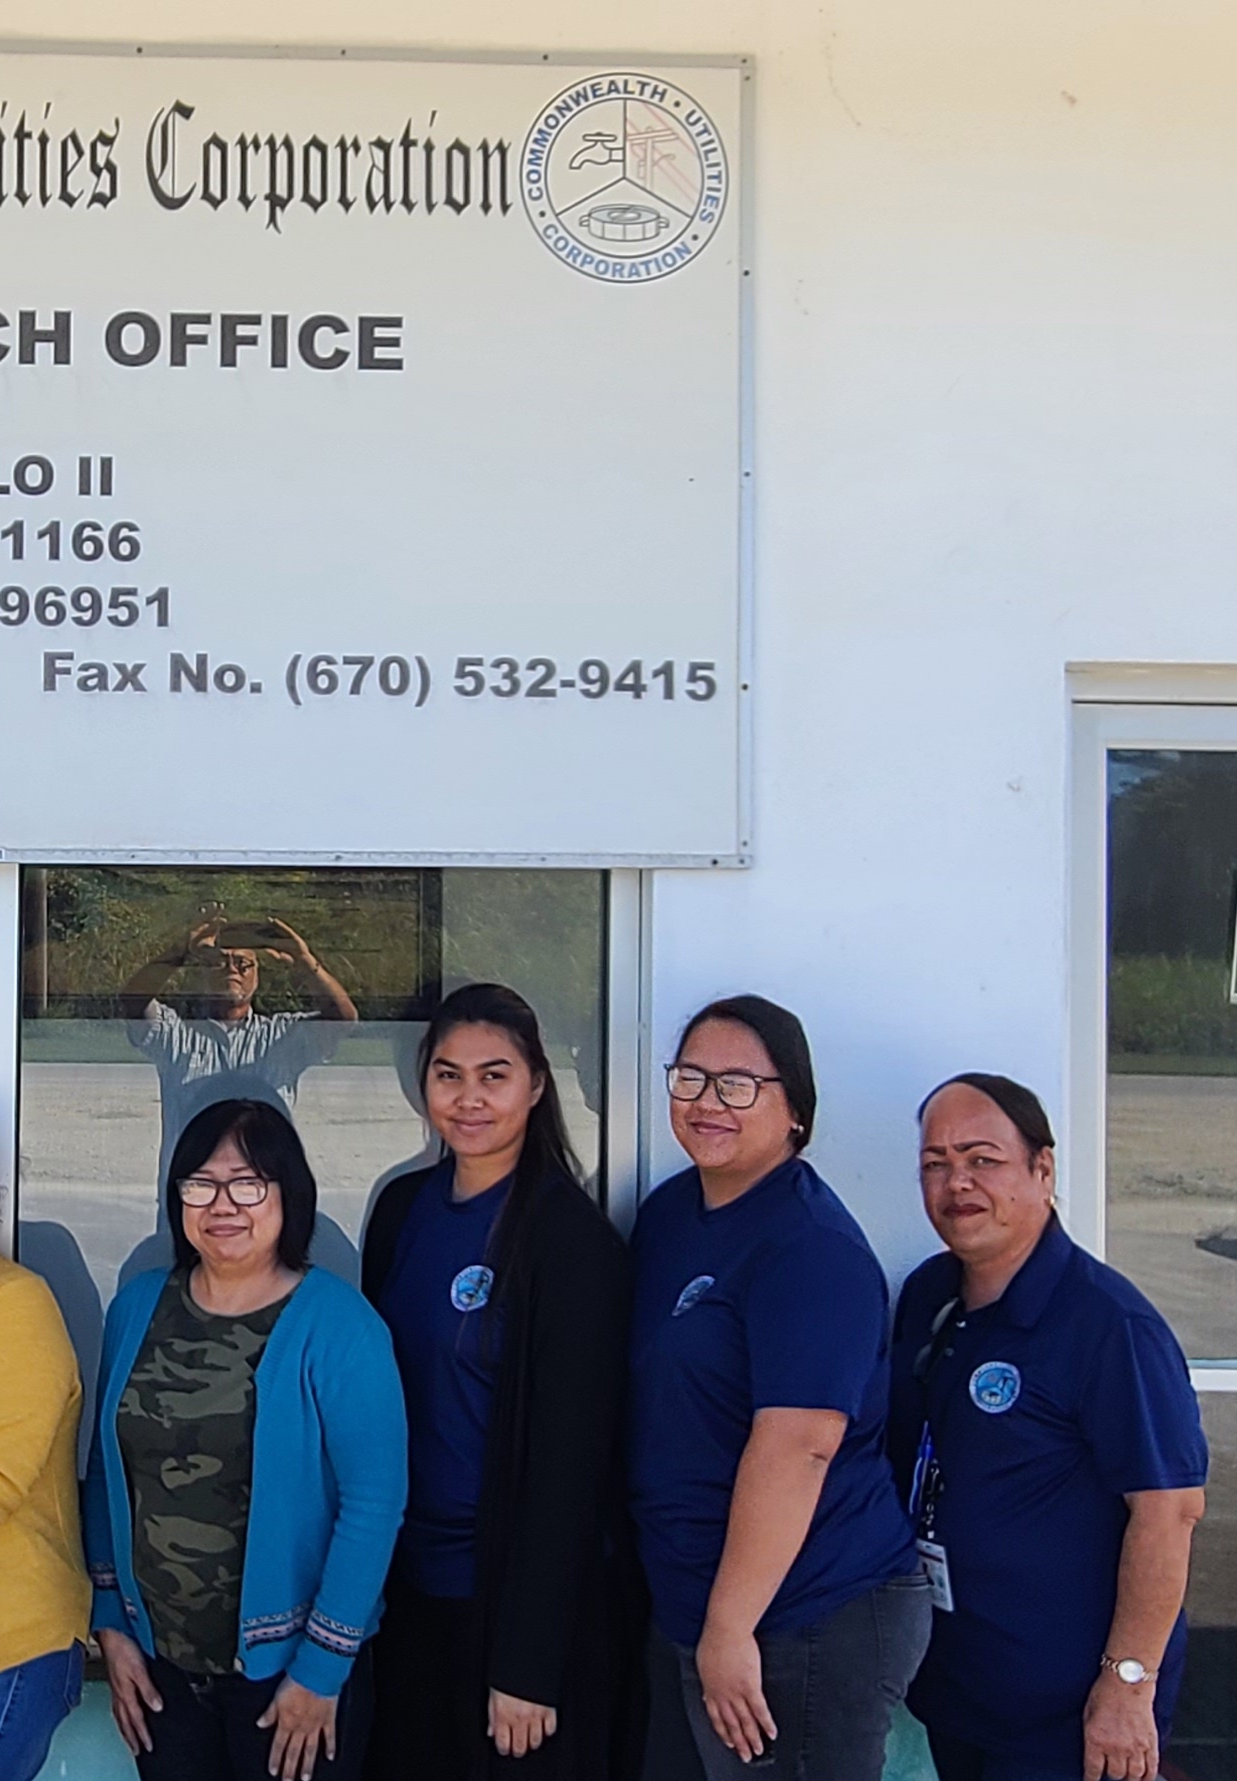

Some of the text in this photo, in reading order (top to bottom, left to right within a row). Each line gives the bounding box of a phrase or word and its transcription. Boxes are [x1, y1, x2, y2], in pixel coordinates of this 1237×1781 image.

[146, 100, 513, 234] Corporation
[526, 79, 722, 224] COMMONWEALTH UTILITIES
[542, 223, 693, 278] CORPORATION
[105, 311, 404, 371] OFFICE
[79, 457, 113, 497] II
[1, 520, 140, 562] 1166
[44, 652, 147, 693] Fax
[171, 654, 262, 694] No.
[287, 654, 429, 707] (670)
[455, 658, 717, 702] 532-9415
